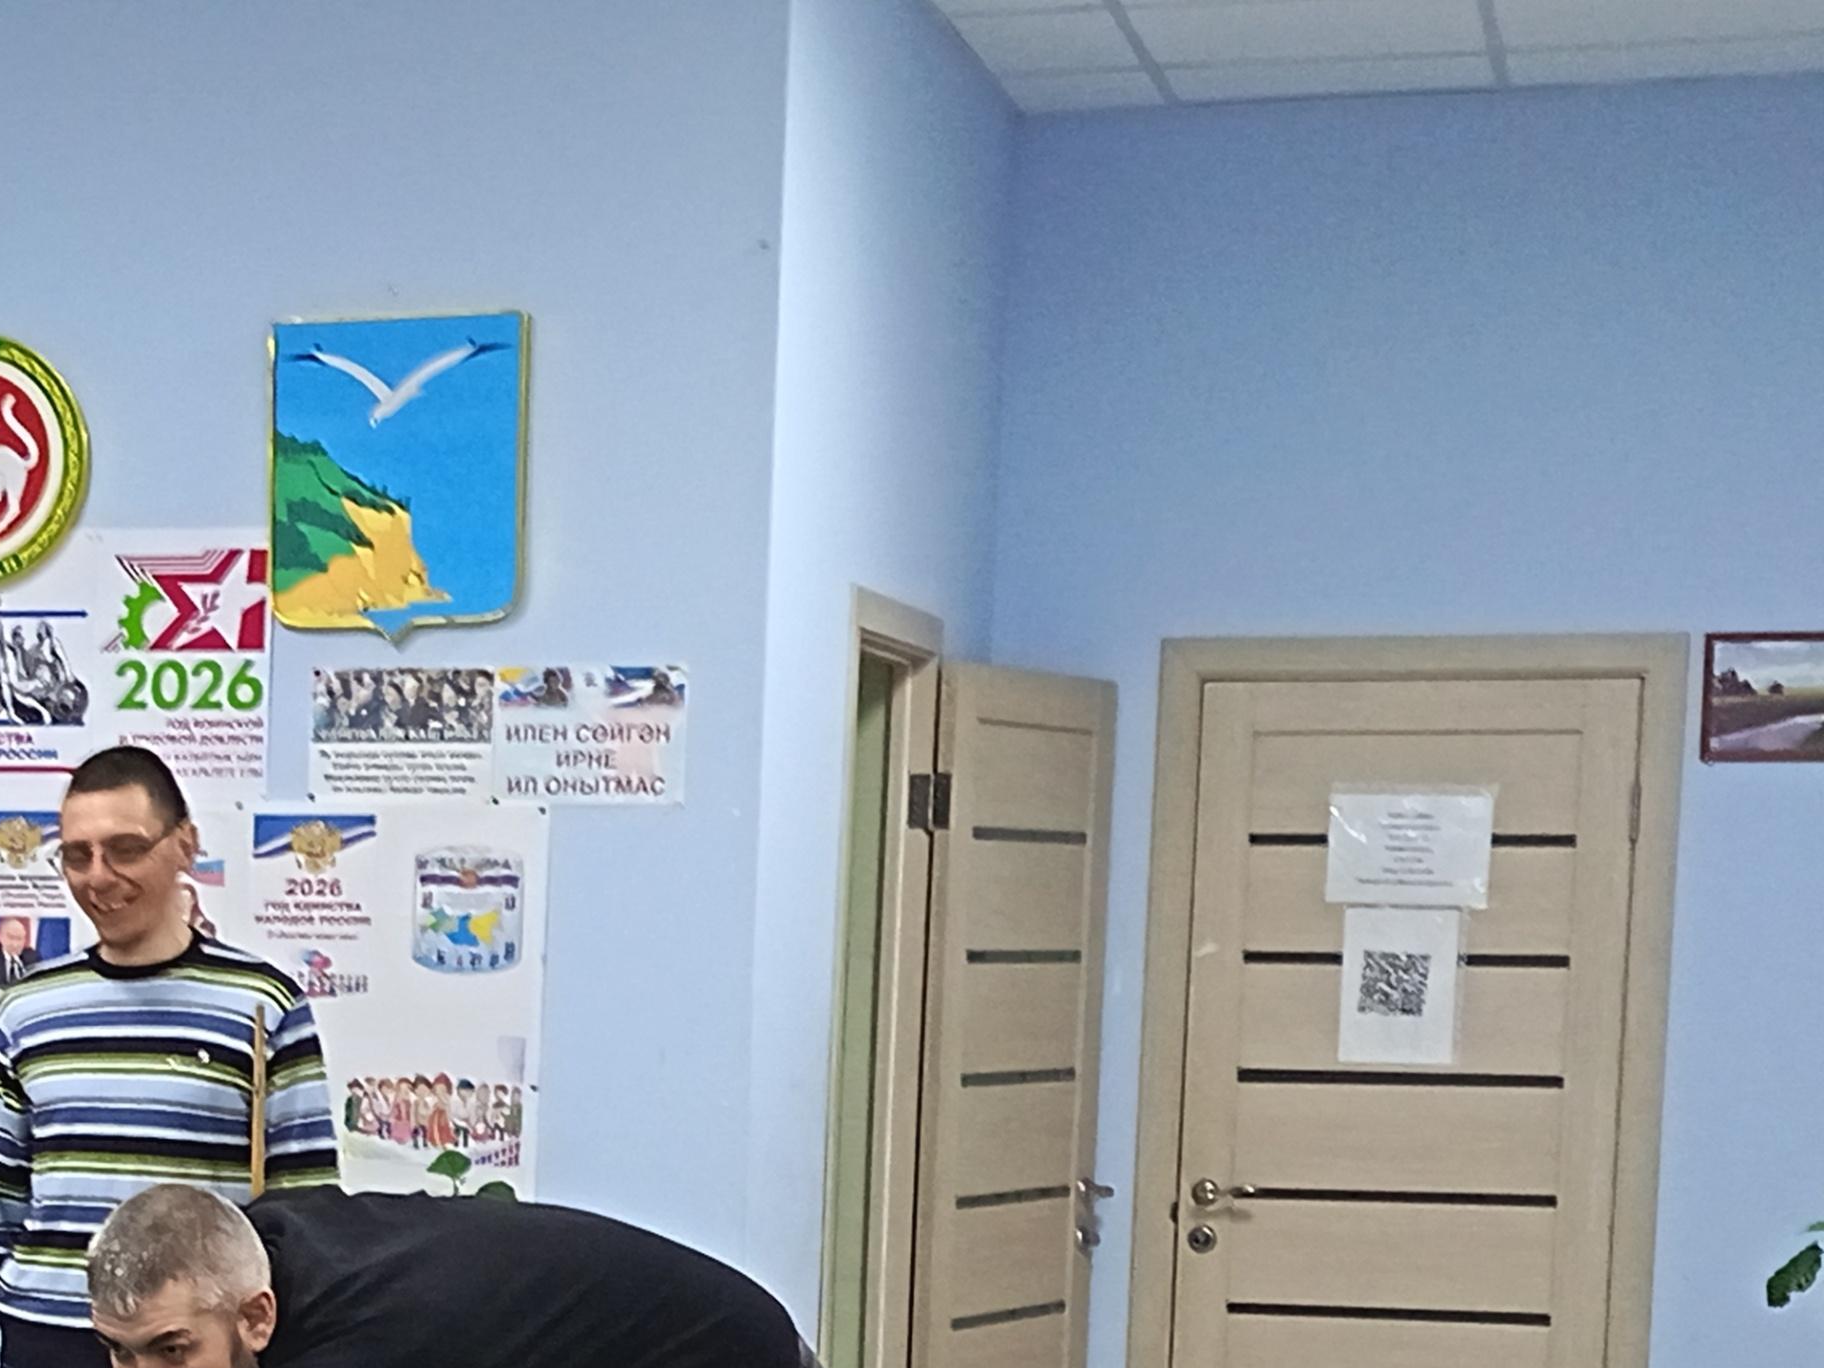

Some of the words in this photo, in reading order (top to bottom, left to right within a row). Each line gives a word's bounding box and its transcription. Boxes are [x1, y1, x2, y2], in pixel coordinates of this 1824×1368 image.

[115, 659, 263, 711] 2026
[506, 723, 567, 744] ИЛЕН
[556, 748, 617, 769] ИРНЕ
[507, 775, 538, 795] ИЛ
[545, 775, 666, 796] ОНЫТМАС
[285, 878, 343, 896] 2026
